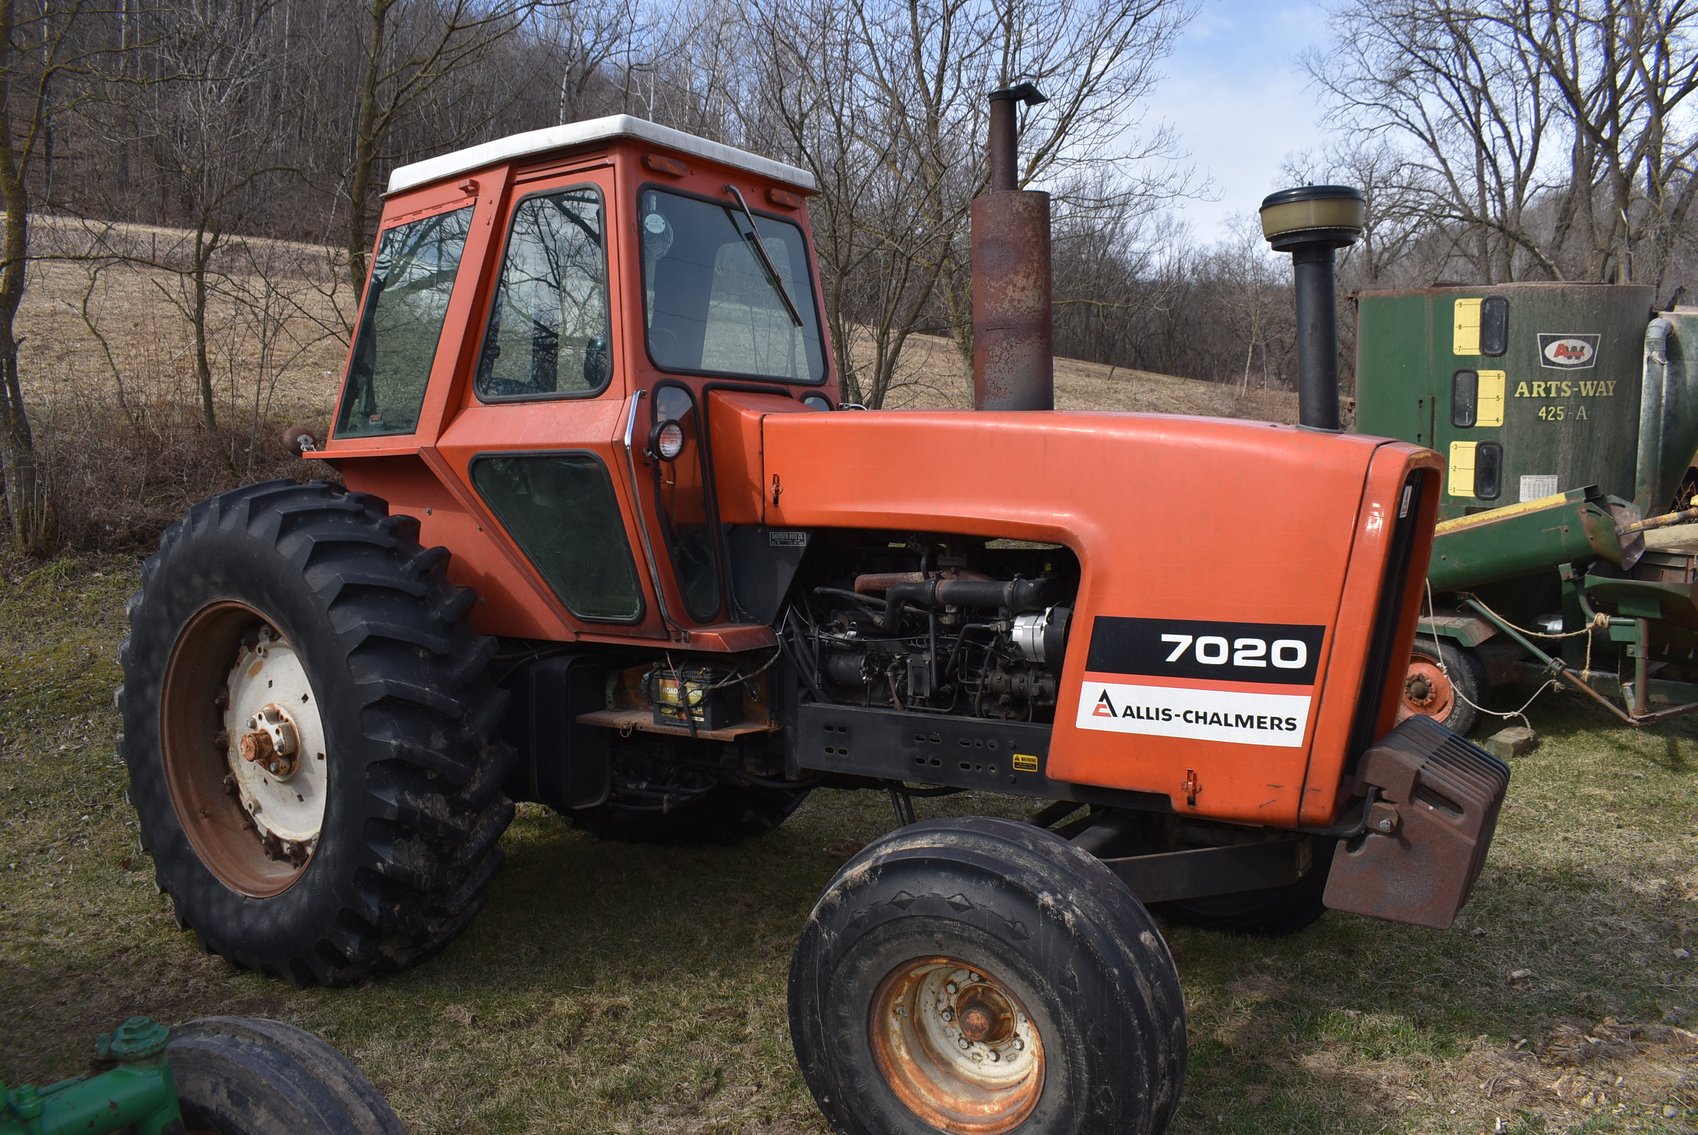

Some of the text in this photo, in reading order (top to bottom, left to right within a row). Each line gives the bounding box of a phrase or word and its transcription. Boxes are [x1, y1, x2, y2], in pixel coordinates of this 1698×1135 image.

[1514, 380, 1617, 397] ARTS-WAY
[1160, 633, 1308, 669] 7020
[1121, 704, 1298, 732] ALLIS-CHALMERS
